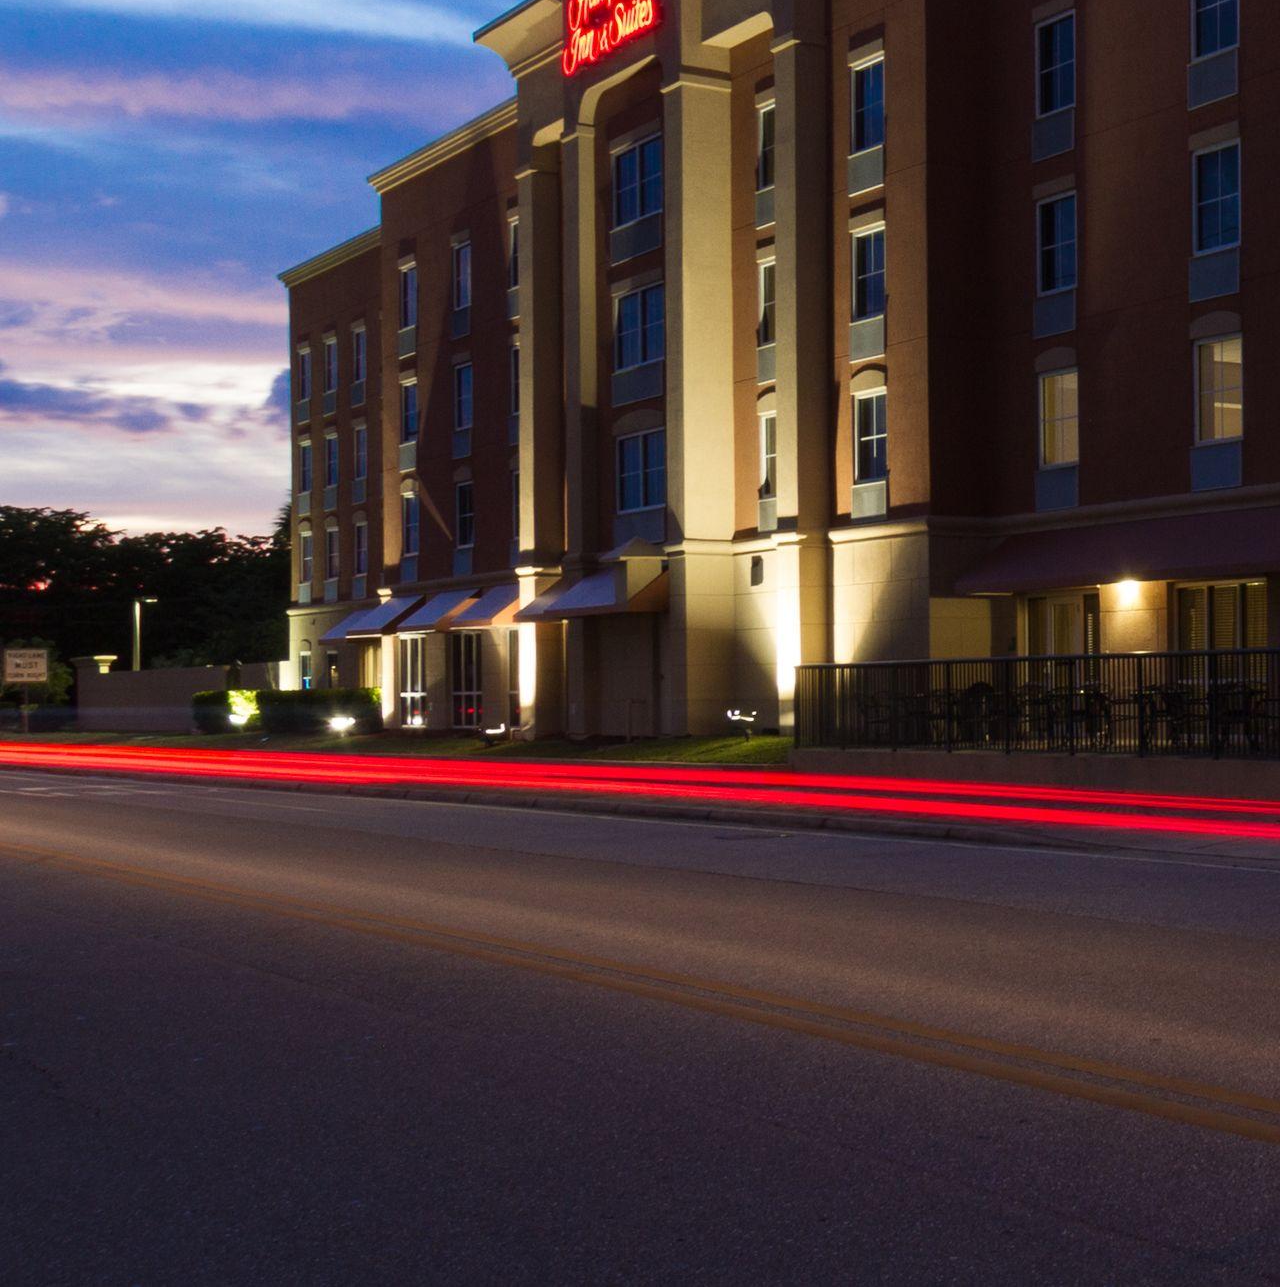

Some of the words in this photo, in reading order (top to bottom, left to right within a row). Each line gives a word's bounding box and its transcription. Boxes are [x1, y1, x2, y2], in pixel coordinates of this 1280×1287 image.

[563, 27, 601, 75] Inn
[599, 22, 610, 52] &
[15, 661, 39, 669] MUST
